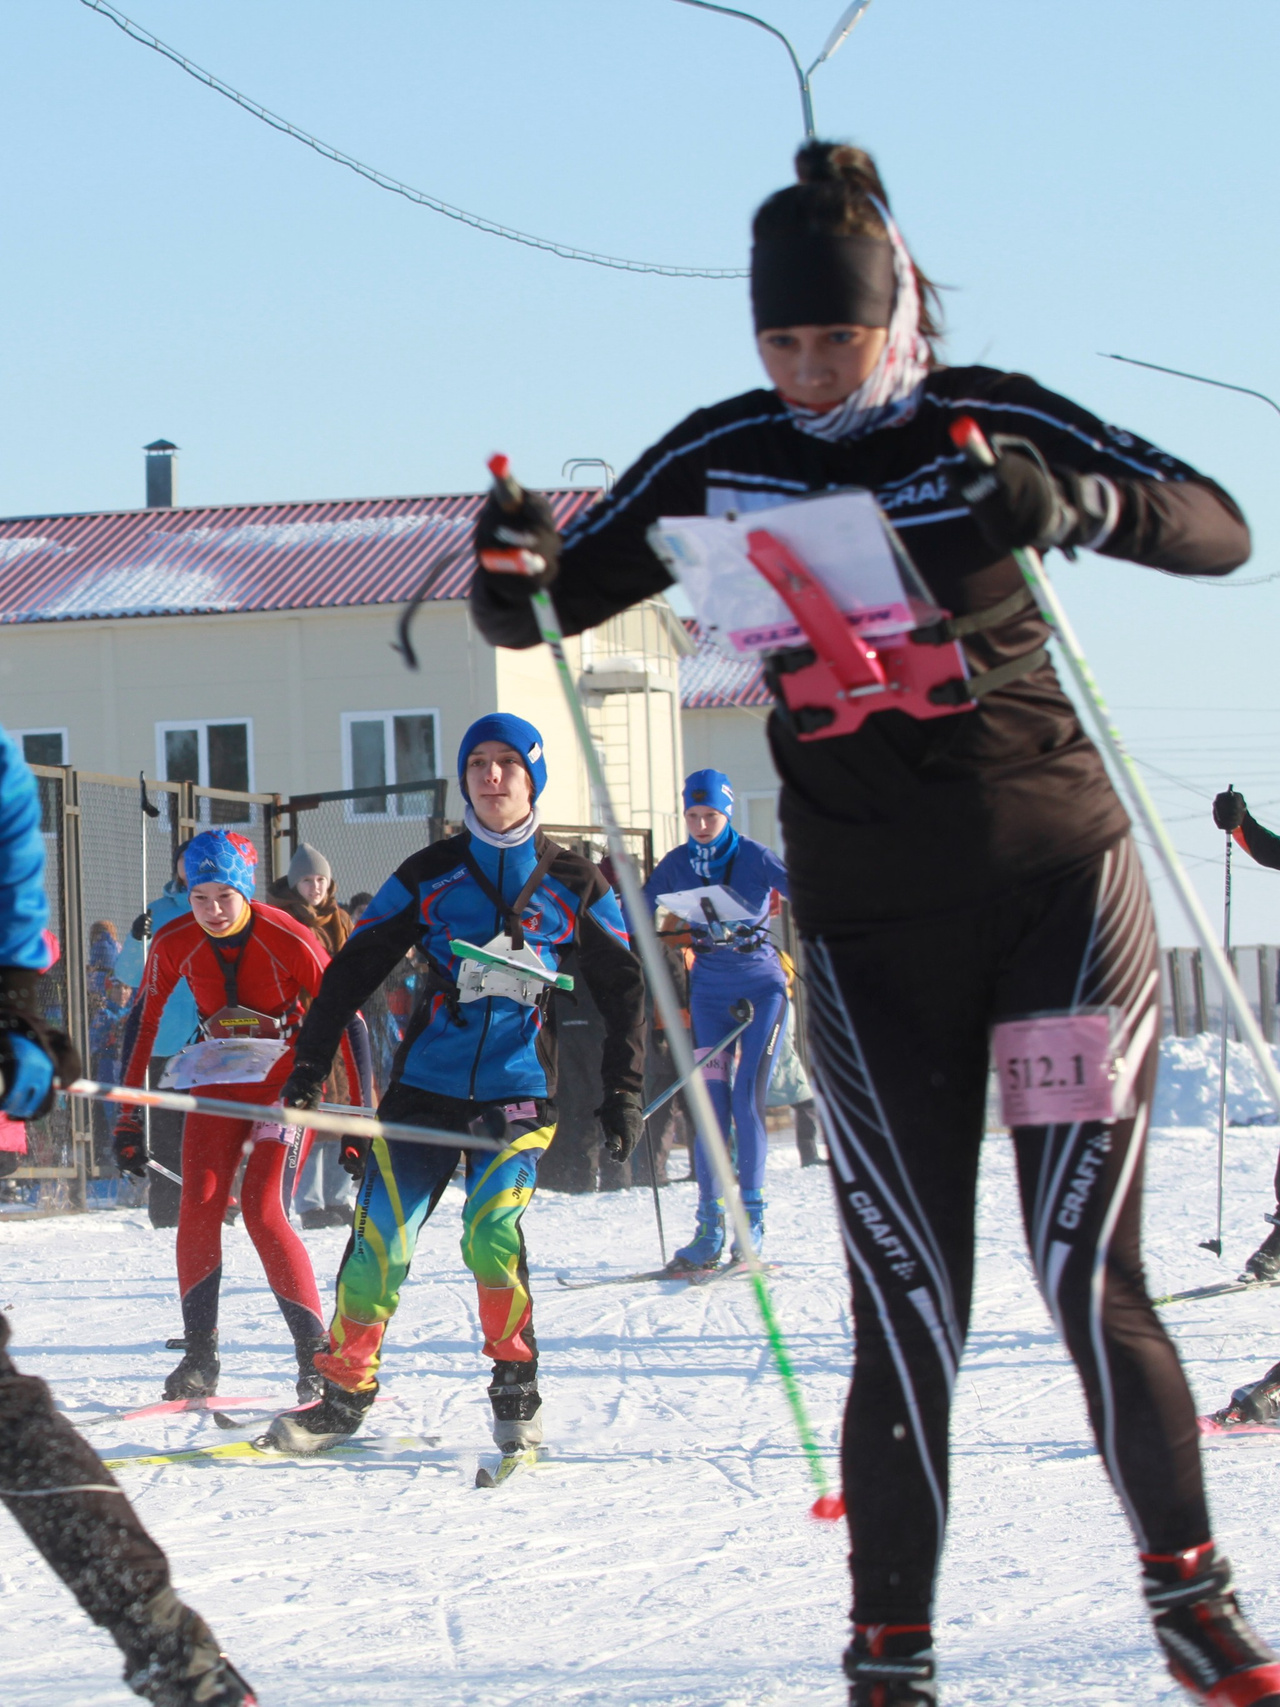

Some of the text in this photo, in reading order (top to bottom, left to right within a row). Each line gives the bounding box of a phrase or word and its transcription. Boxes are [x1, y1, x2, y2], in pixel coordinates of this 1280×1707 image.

[877, 475, 949, 511] CRAF
[1007, 1053, 1086, 1091] 512.1
[1055, 1149, 1104, 1231] CRAFT
[848, 1190, 910, 1259] CRAFT
